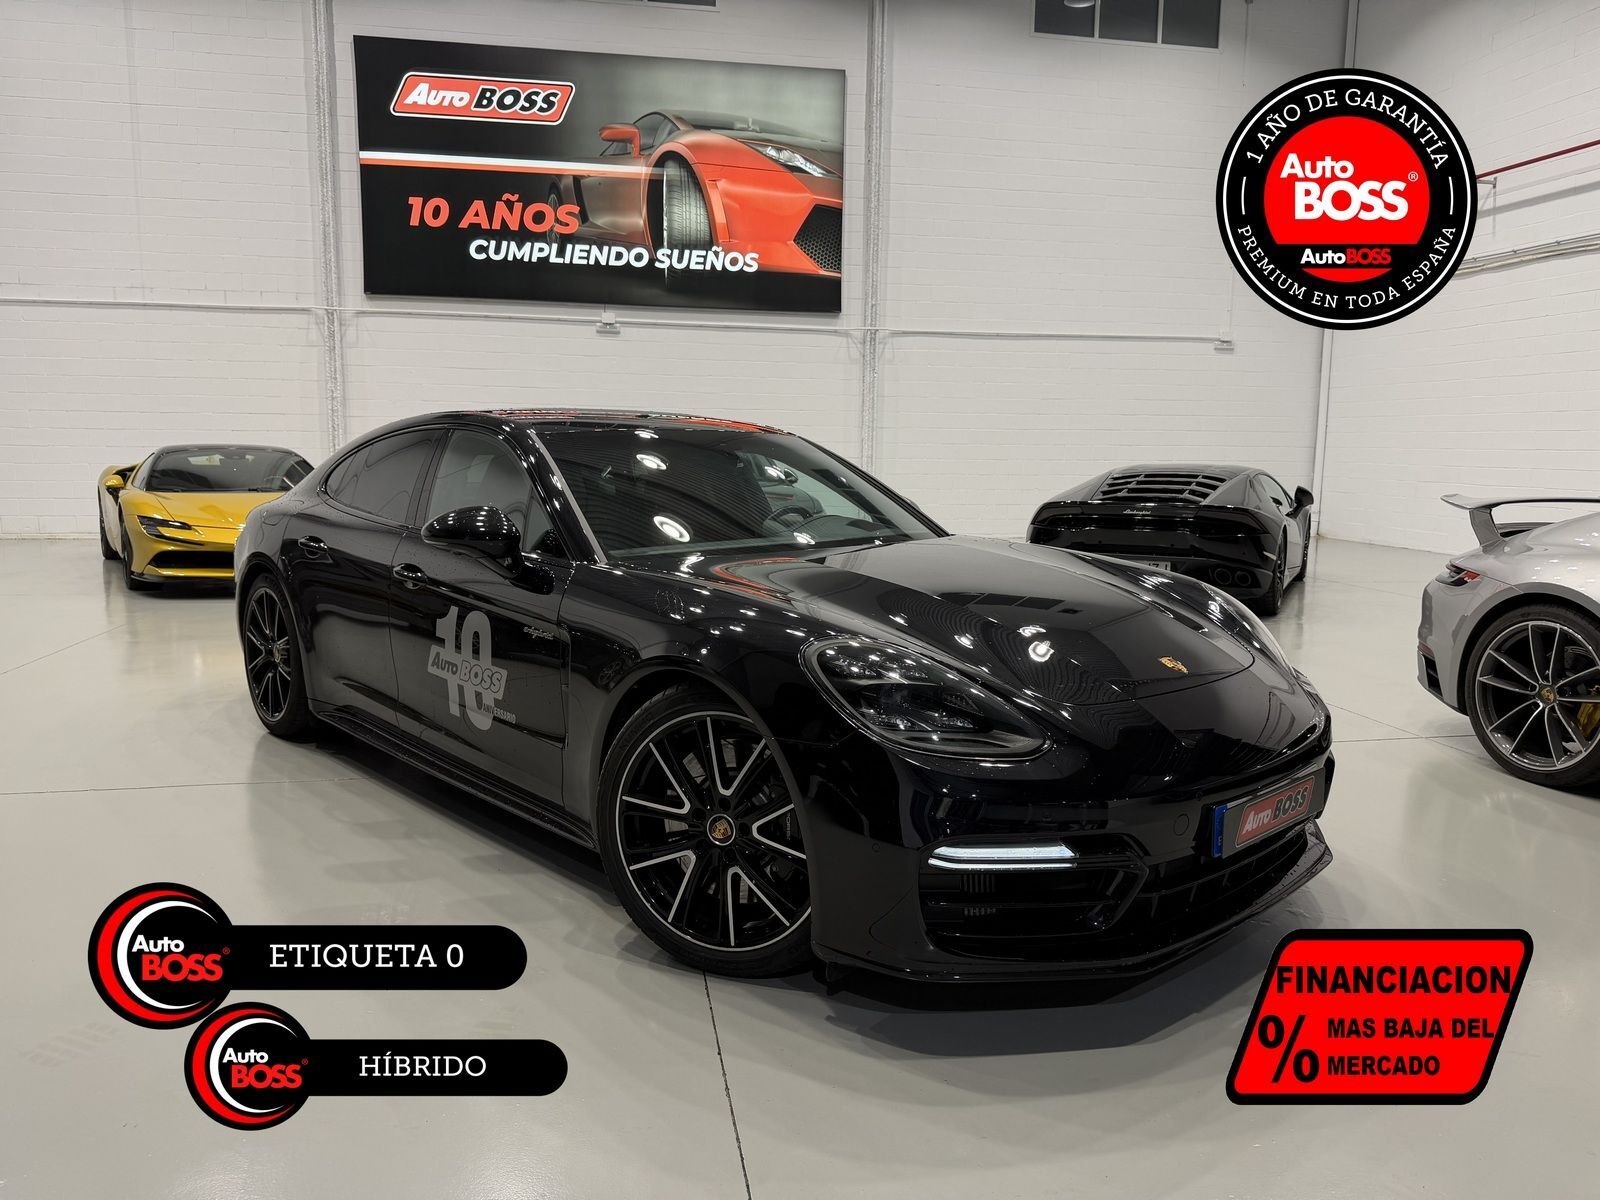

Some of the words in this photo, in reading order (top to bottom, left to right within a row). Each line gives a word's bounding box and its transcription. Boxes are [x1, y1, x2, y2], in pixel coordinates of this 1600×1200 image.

[472, 86, 561, 114] BOSS
[406, 196, 450, 228] 10
[458, 194, 581, 234] AÑOS
[468, 238, 650, 269] CUMPLIENDO
[655, 245, 759, 273] SUEÑOS
[435, 605, 494, 730] 10
[460, 660, 503, 693] BOSS
[1271, 785, 1309, 822] BOSS
